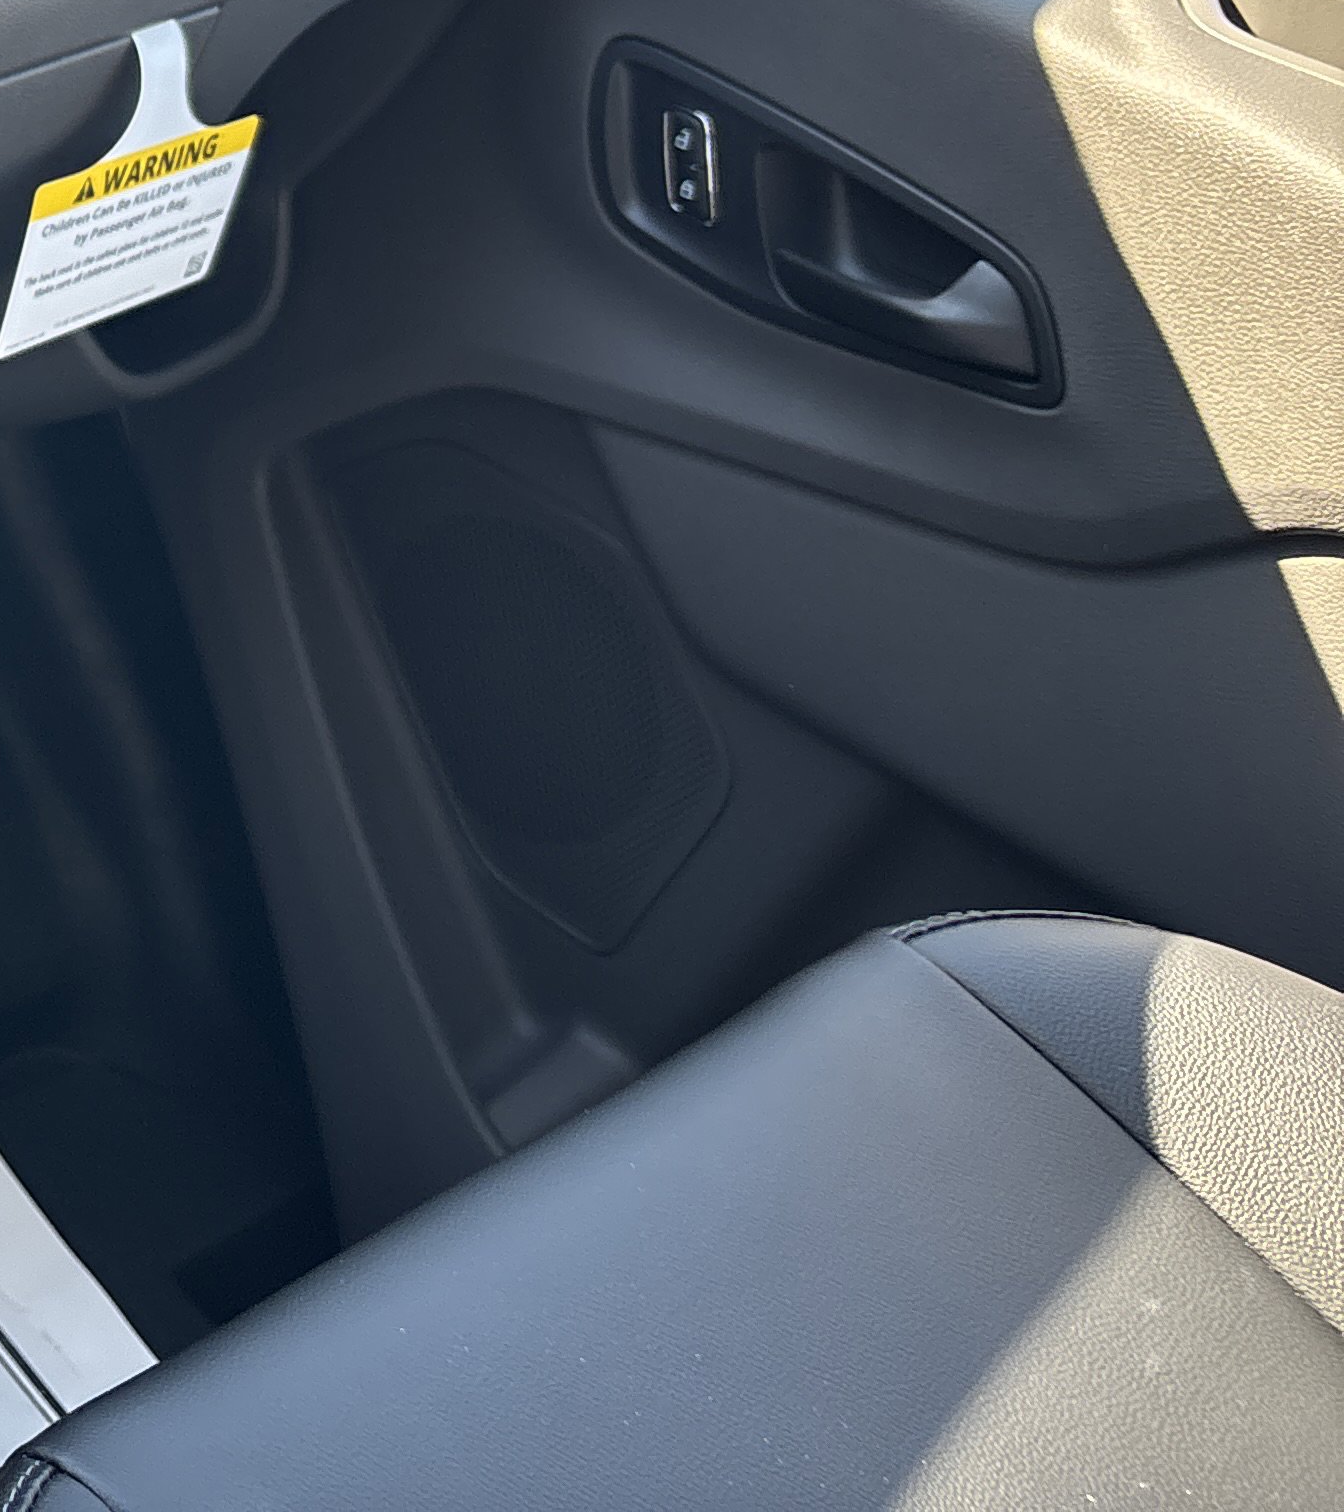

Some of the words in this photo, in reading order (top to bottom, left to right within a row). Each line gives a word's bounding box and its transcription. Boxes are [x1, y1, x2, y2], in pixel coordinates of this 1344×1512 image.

[103, 133, 220, 195] WARNING
[41, 213, 90, 239] Children
[92, 205, 114, 221] Can
[132, 182, 172, 205] KILLED
[73, 231, 88, 248] by
[90, 211, 147, 241] Passenger
[147, 202, 166, 219] Air
